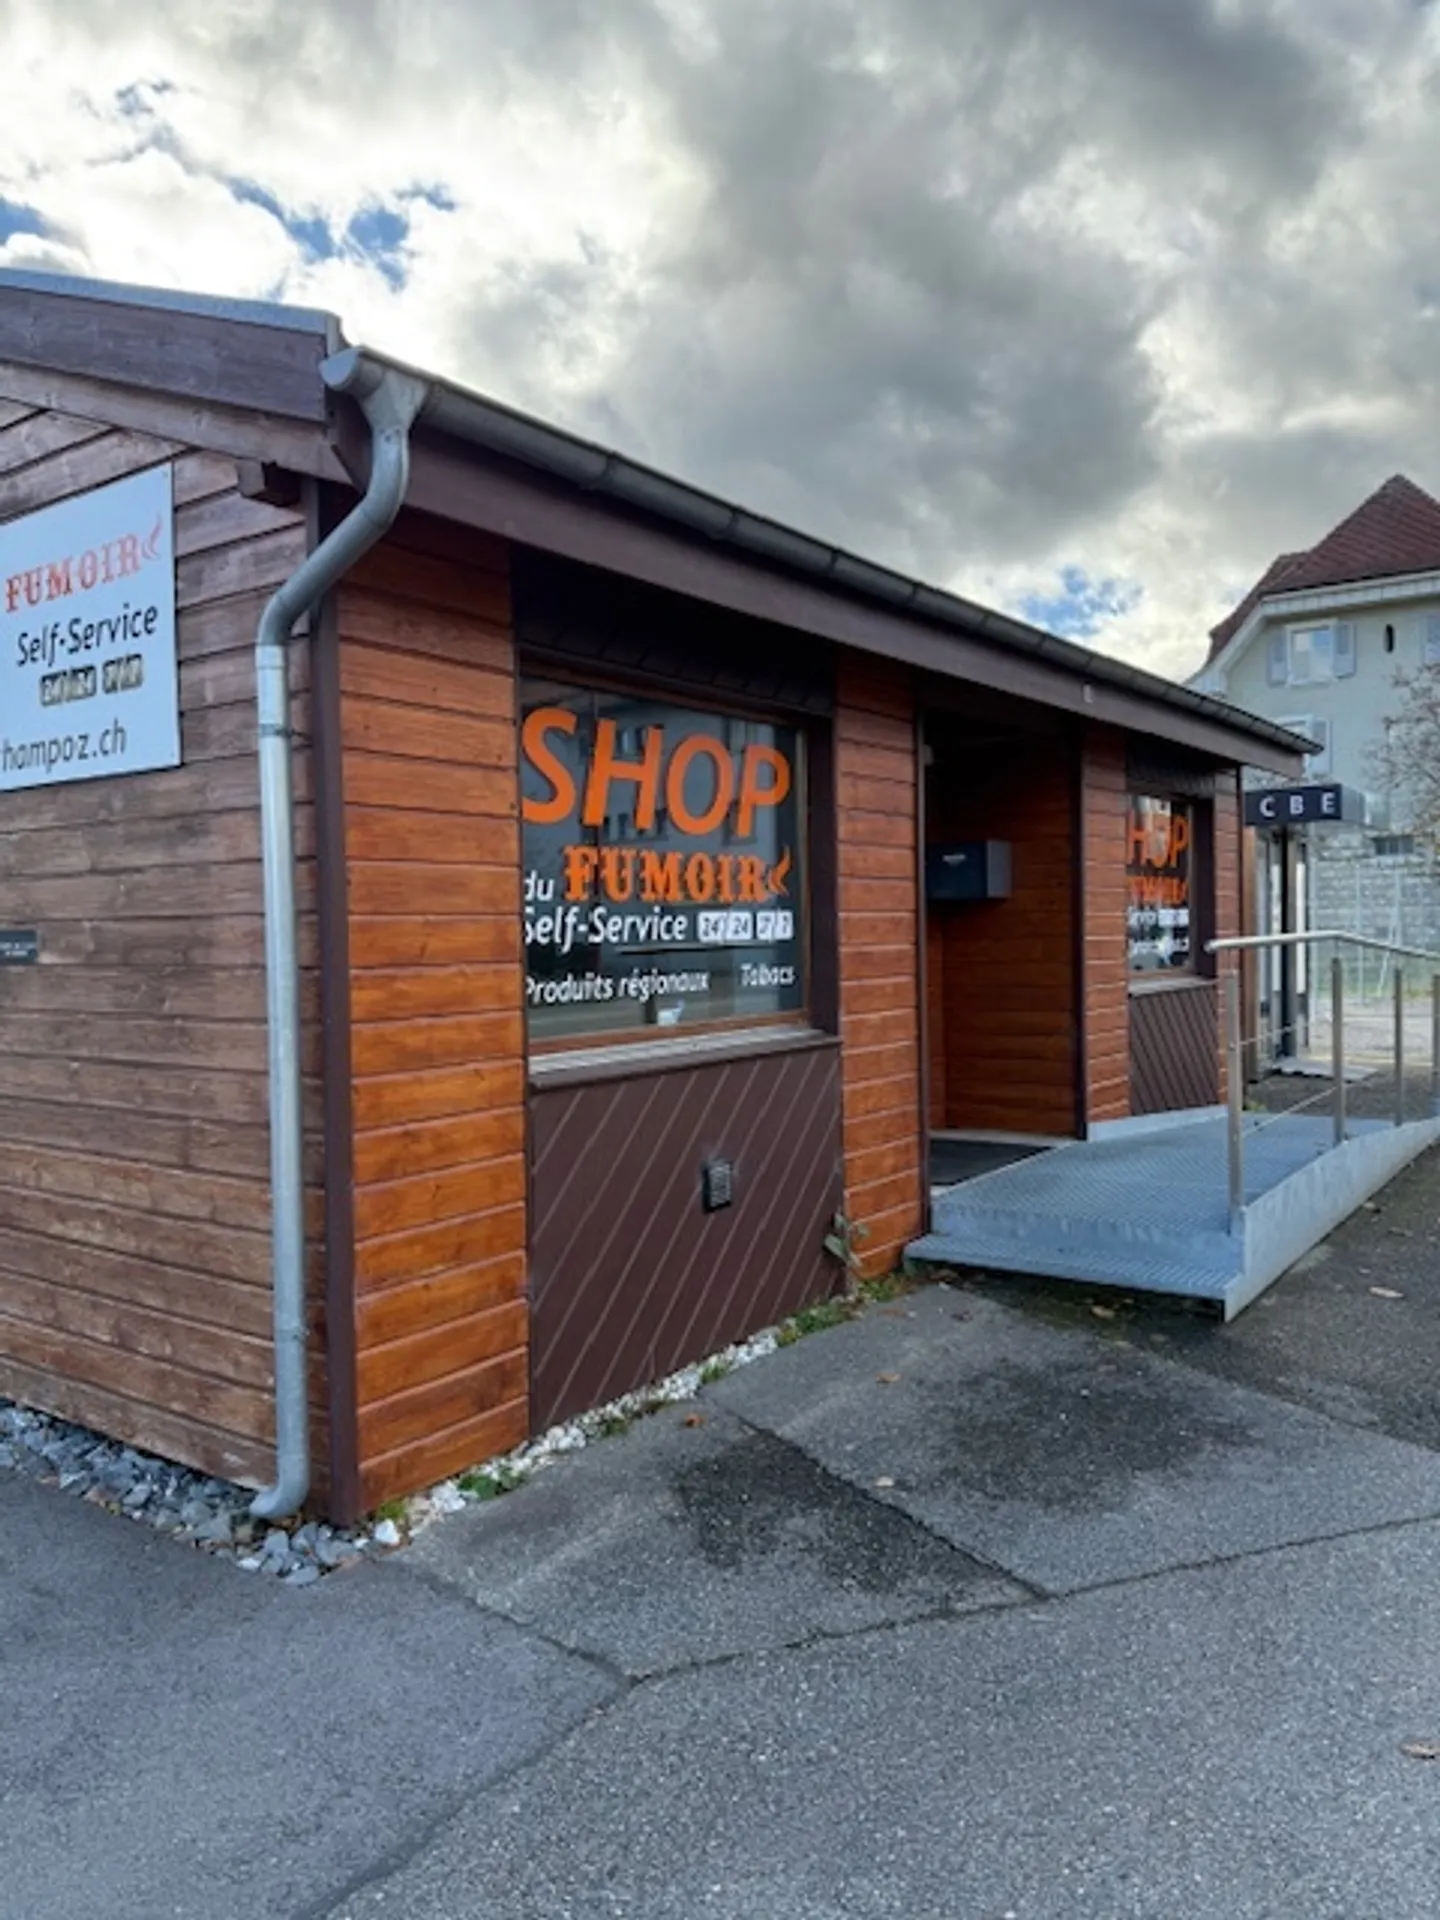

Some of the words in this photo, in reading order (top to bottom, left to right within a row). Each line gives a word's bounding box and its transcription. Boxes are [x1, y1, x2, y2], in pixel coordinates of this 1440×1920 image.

[5, 532, 142, 613] FUMOIR
[16, 602, 158, 668] Self-Service
[522, 706, 790, 837] SHOP
[563, 845, 768, 904] FUMOIR
[618, 968, 709, 1002] régionaux
[740, 964, 796, 987] Tabacs
